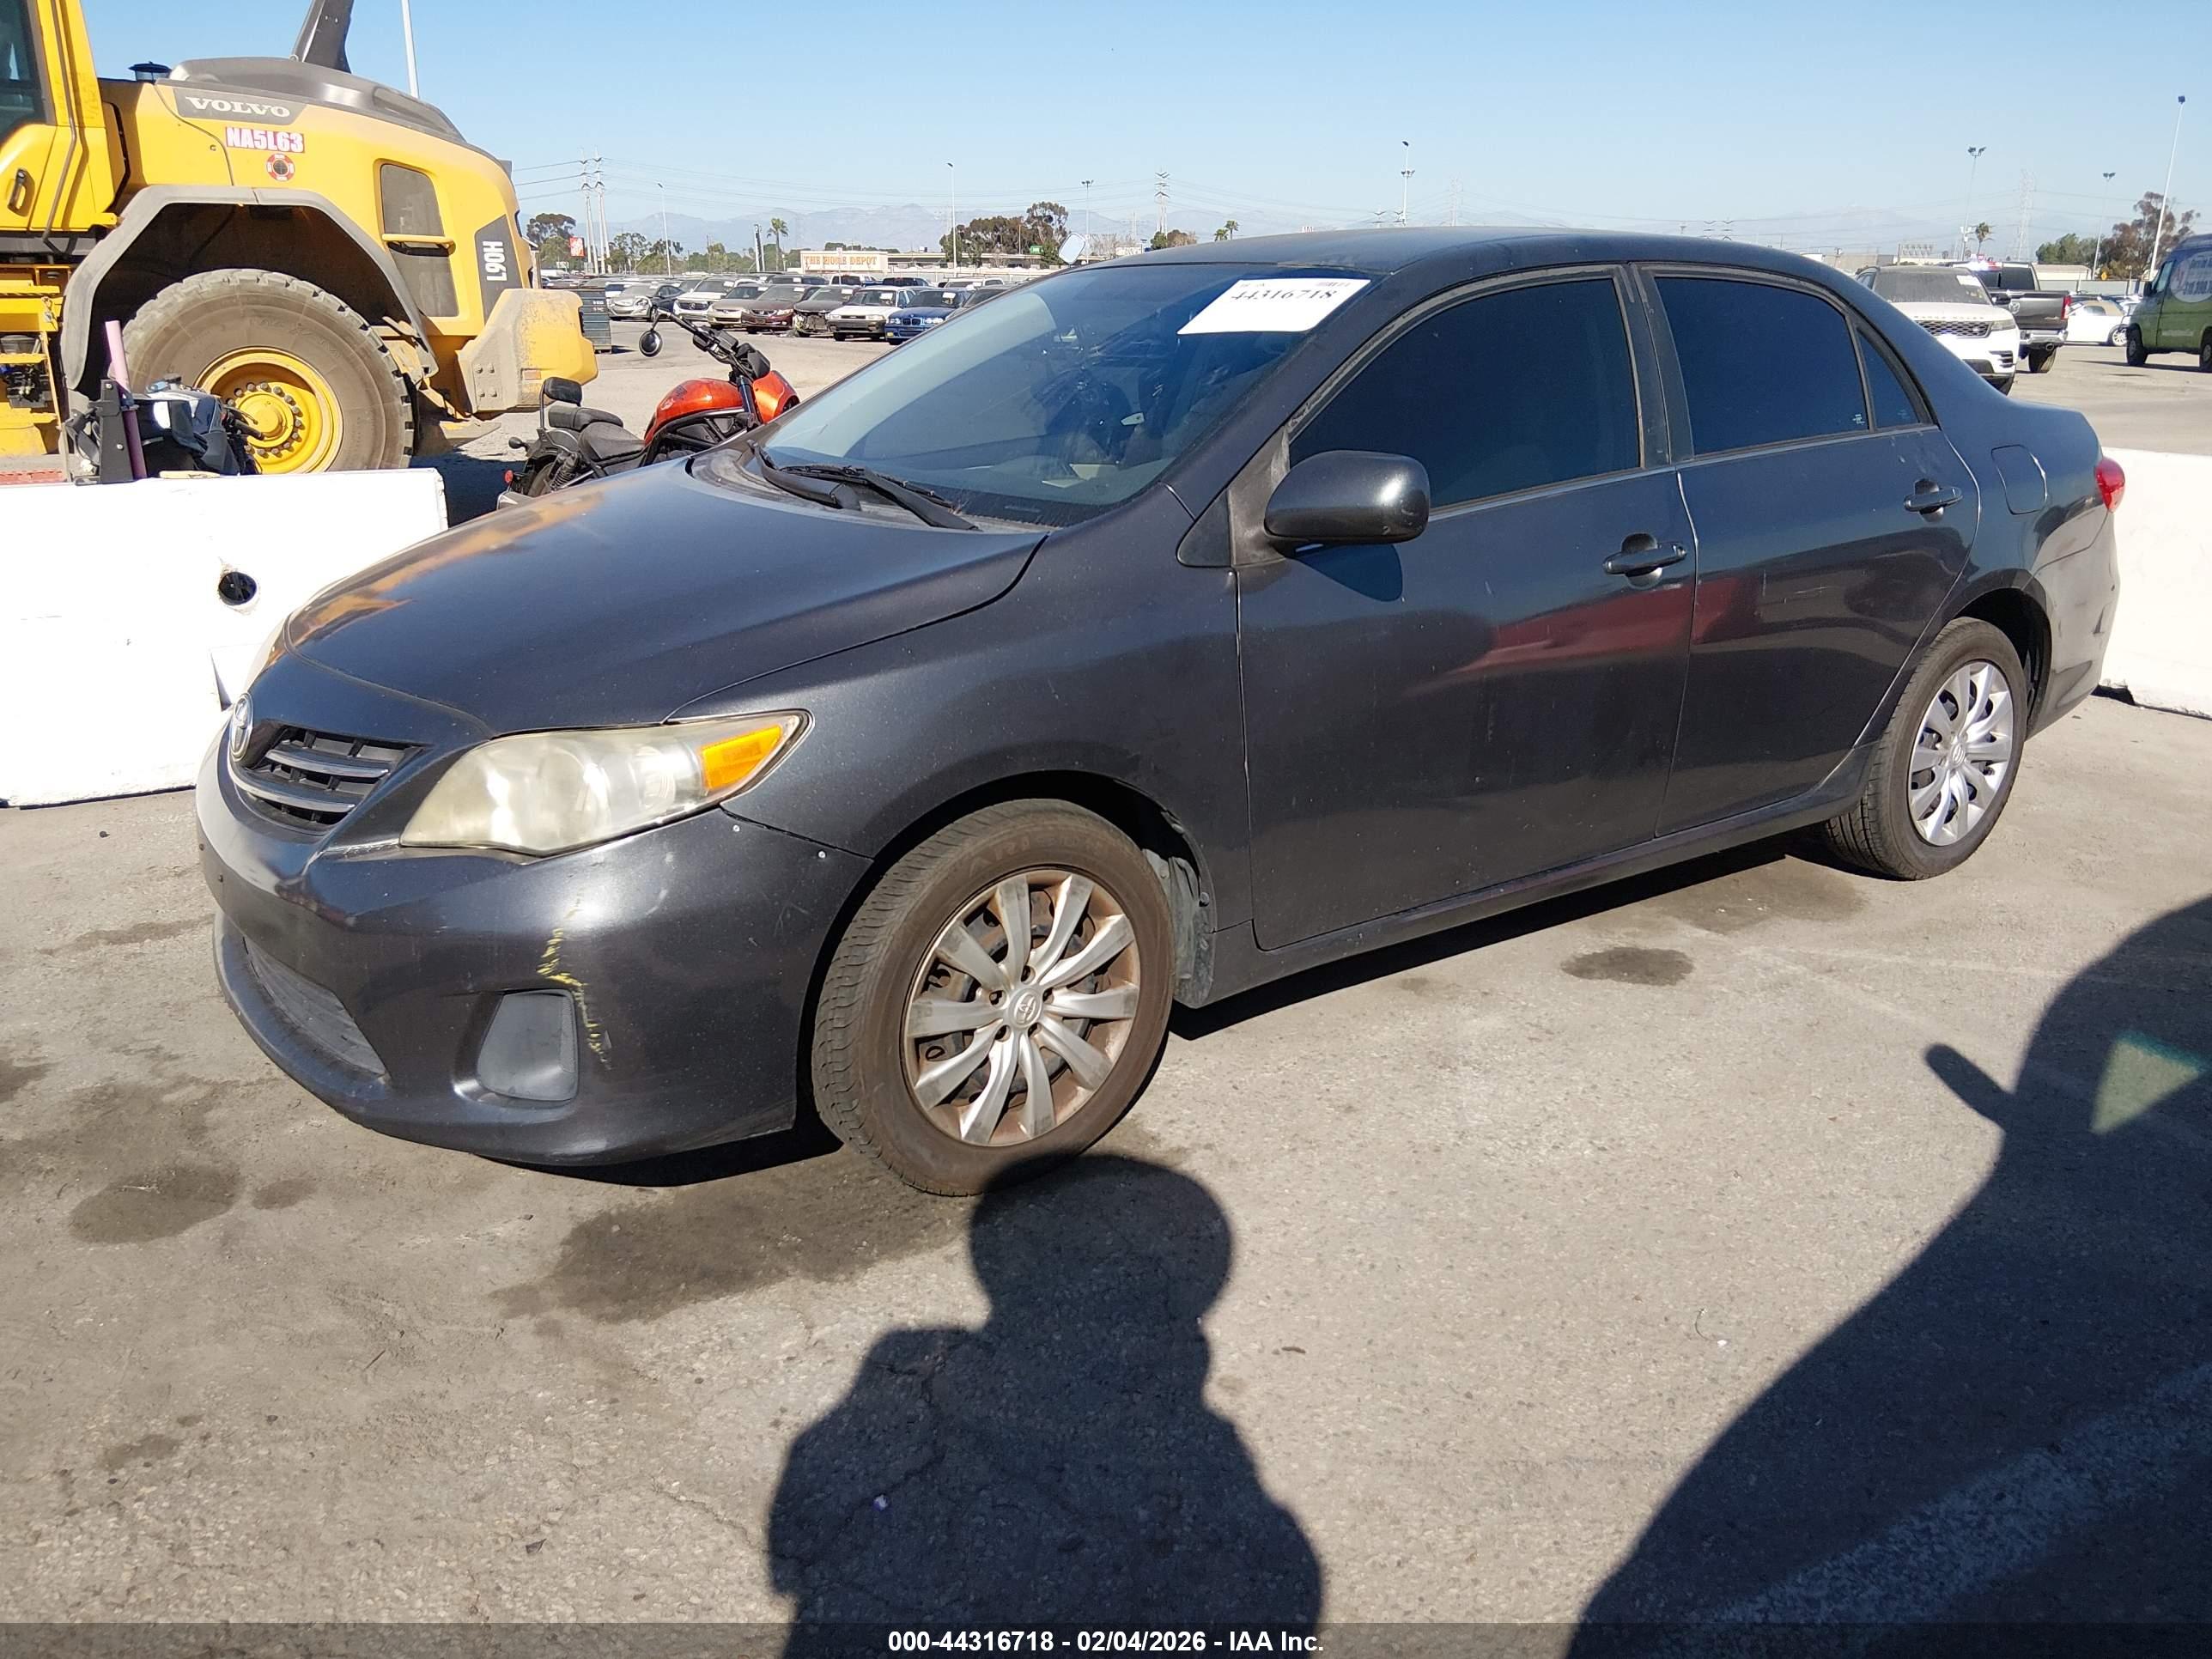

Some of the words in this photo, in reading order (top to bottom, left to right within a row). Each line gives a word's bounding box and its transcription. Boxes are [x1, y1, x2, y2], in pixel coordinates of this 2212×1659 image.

[185, 96, 290, 118] VOLVO
[226, 126, 304, 153] NA5L63
[482, 240, 508, 283] L90H
[804, 256, 821, 265] THE
[849, 256, 877, 265] DEPOT
[1231, 289, 1338, 301] 44316718
